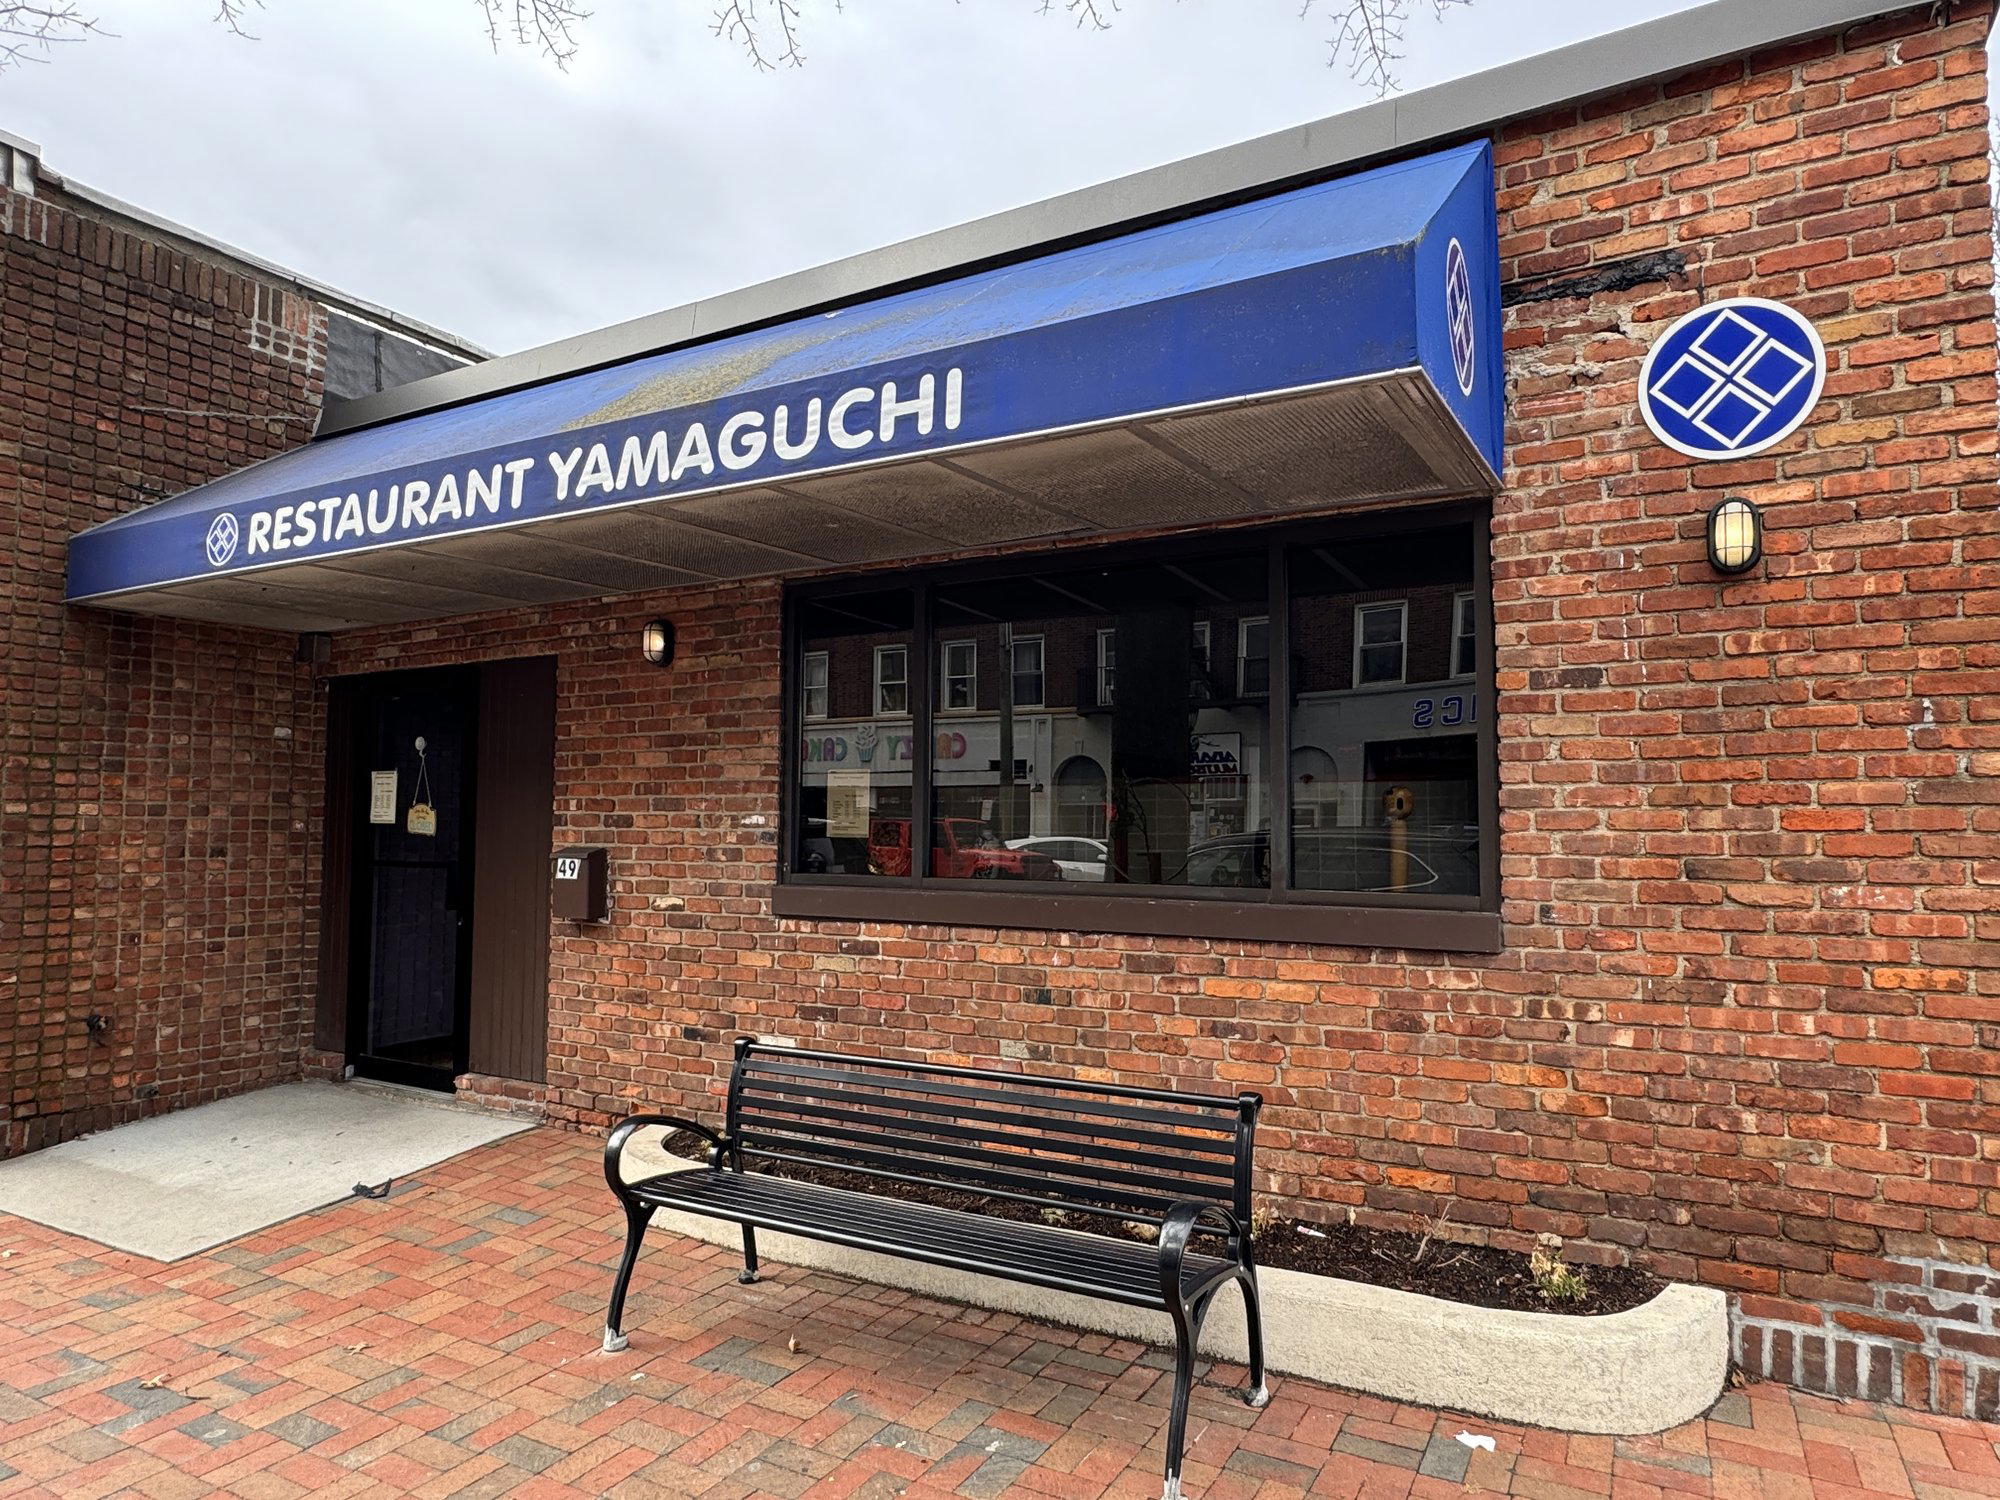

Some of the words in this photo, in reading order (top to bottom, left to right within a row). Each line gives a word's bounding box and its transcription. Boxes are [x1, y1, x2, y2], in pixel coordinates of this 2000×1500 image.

[247, 457, 535, 555] RESTAURANT
[547, 367, 964, 502] YAMAGUCHI
[559, 859, 576, 877] 49
